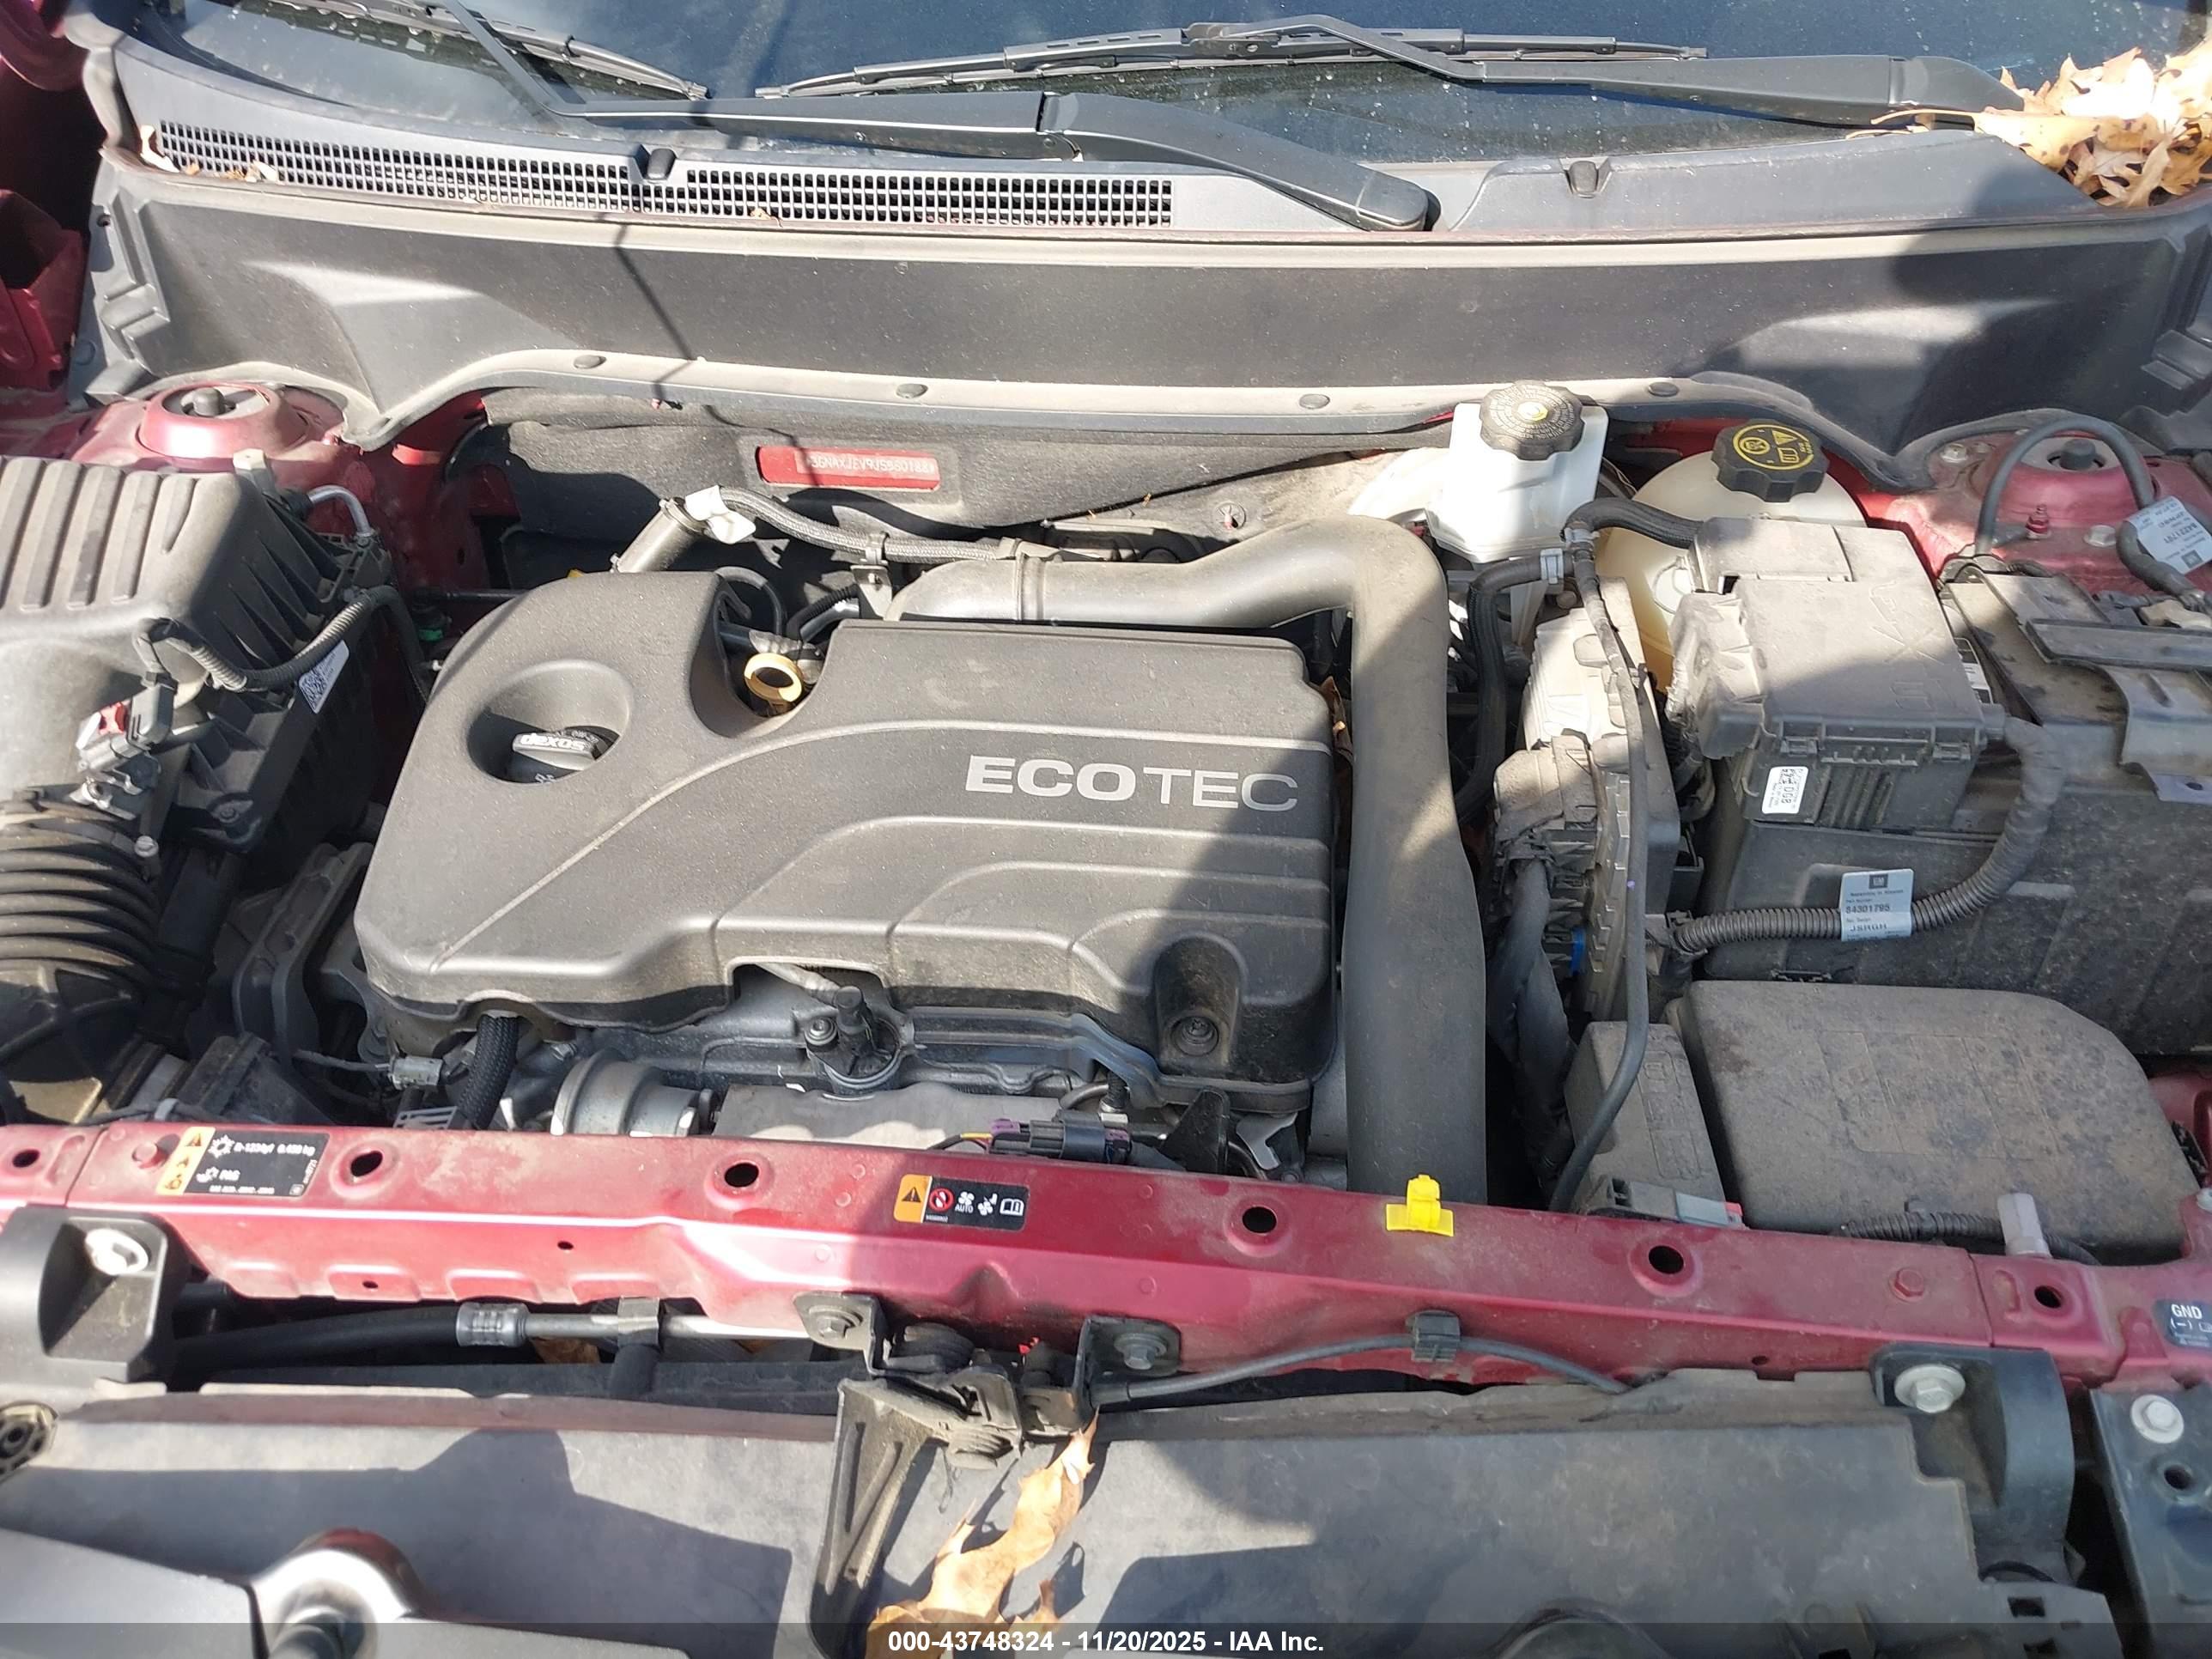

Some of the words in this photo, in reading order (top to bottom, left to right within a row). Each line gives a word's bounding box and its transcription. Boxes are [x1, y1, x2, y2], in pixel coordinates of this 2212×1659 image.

[520, 732, 586, 751] dexos
[965, 755, 1298, 811] ECOTEC
[954, 1204, 974, 1213] AUTO
[2171, 1304, 2203, 1320] GND
